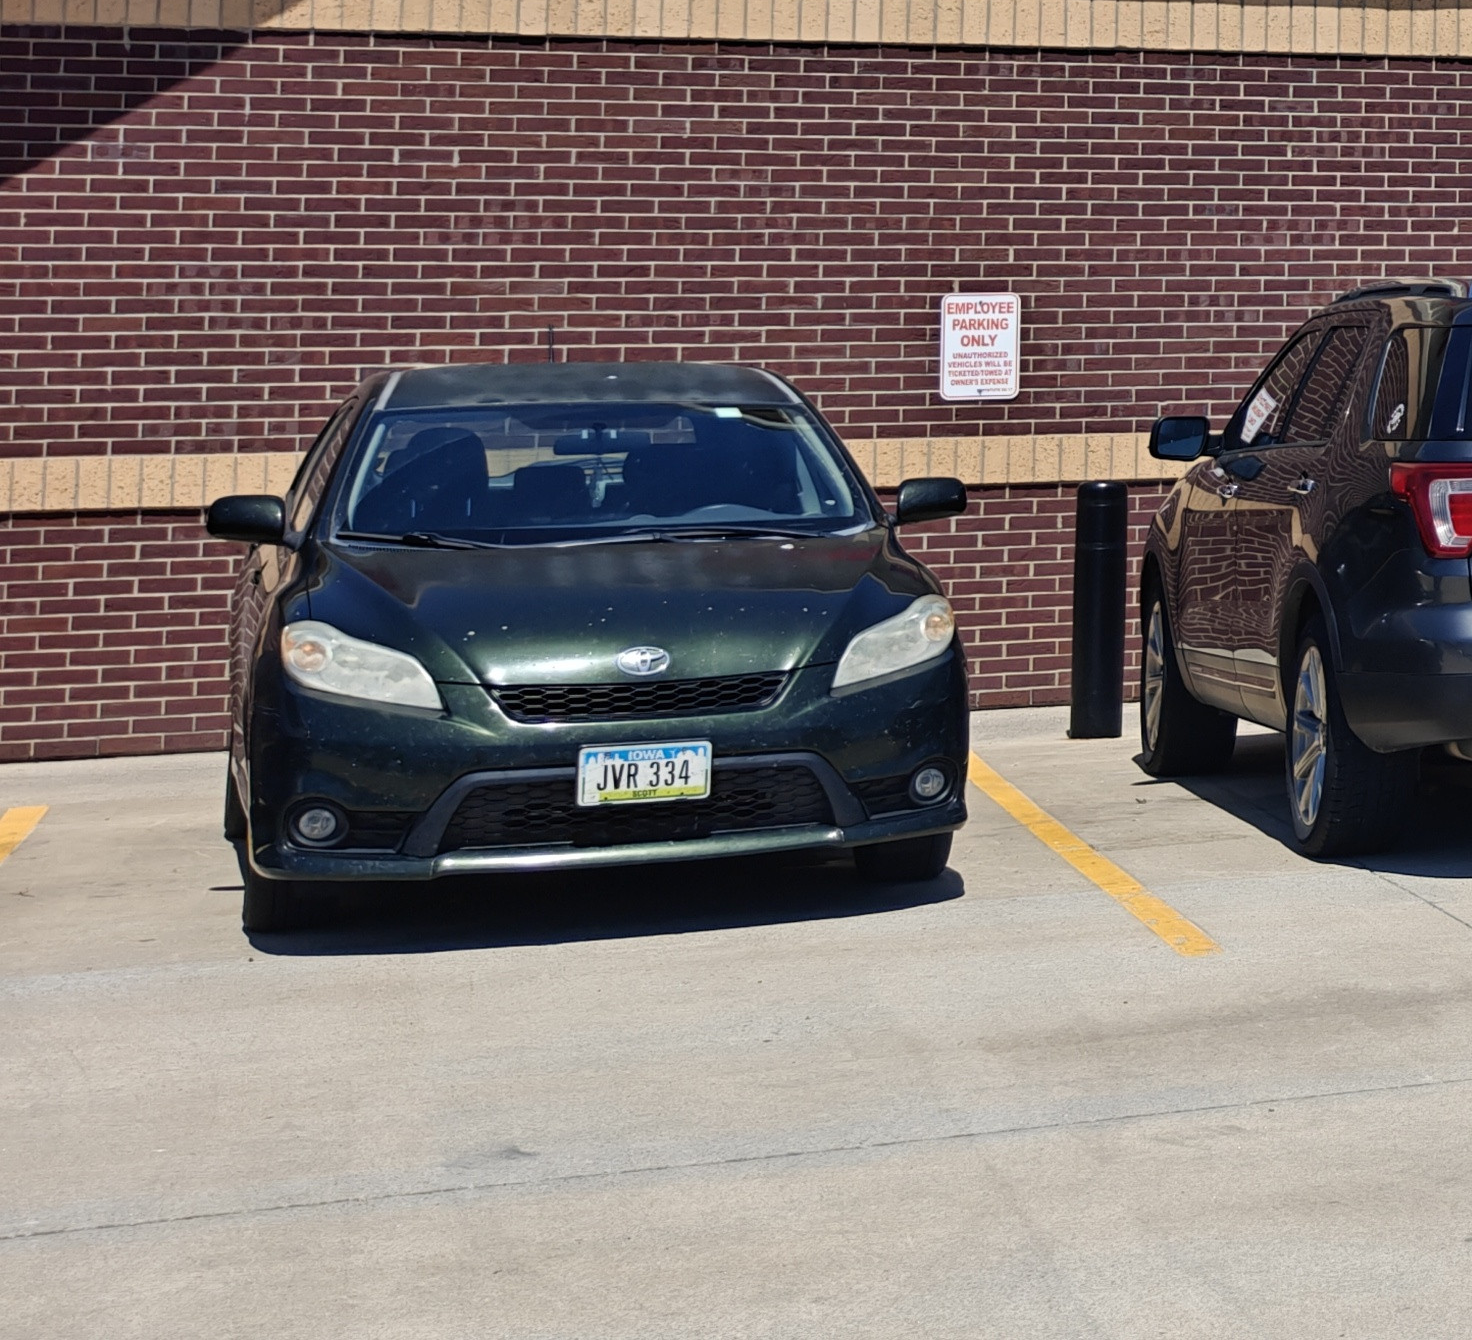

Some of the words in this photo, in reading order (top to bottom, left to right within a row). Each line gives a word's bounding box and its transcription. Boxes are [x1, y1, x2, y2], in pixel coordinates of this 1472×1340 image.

[947, 301, 1014, 315] EMPLOYEE
[952, 318, 1009, 331] PARKING
[960, 334, 998, 347] ONLY
[952, 351, 1008, 359] UNAUTHORIZED
[628, 749, 665, 761] IOWA
[596, 763, 639, 791] JVR
[649, 759, 691, 787] 334
[632, 789, 657, 798] SCOTT
